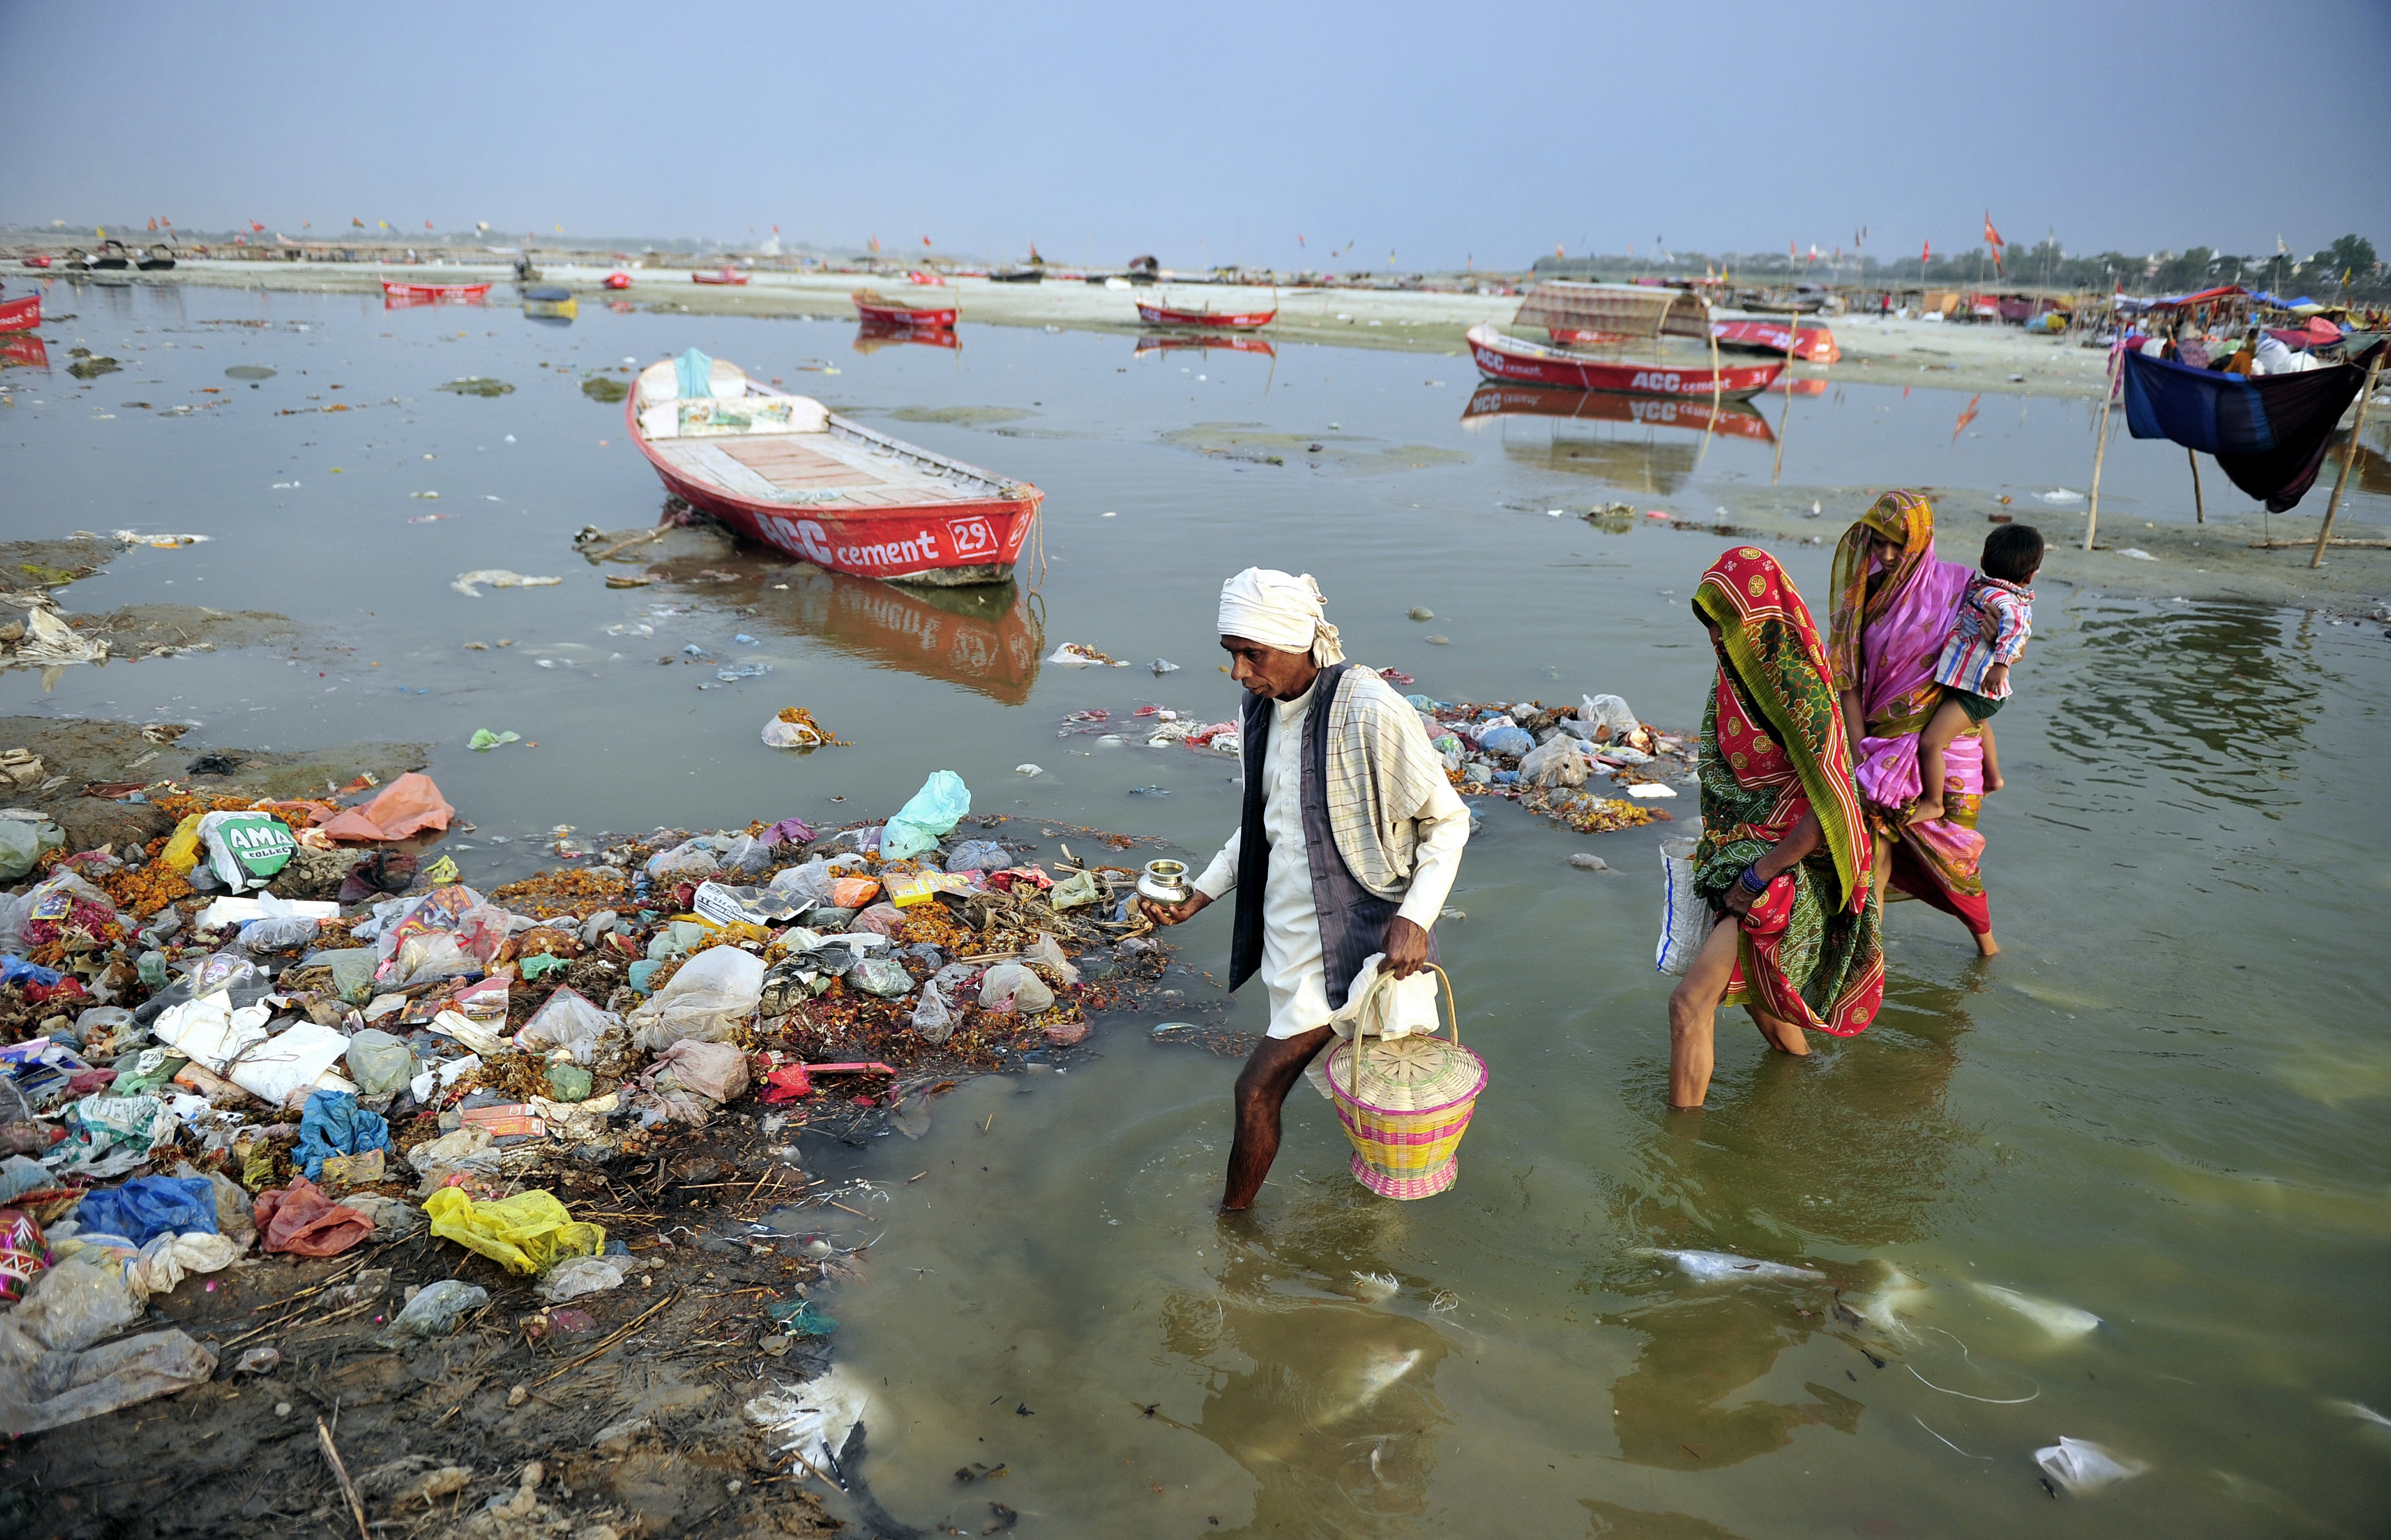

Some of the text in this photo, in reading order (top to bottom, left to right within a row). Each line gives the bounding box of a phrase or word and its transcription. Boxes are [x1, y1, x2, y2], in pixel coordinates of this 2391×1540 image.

[1477, 347, 1504, 371] ACC
[1631, 372, 1681, 391] ACC
[754, 512, 833, 564] ACC
[837, 531, 939, 566] cement
[954, 523, 986, 551] 29
[230, 827, 297, 849] AMA
